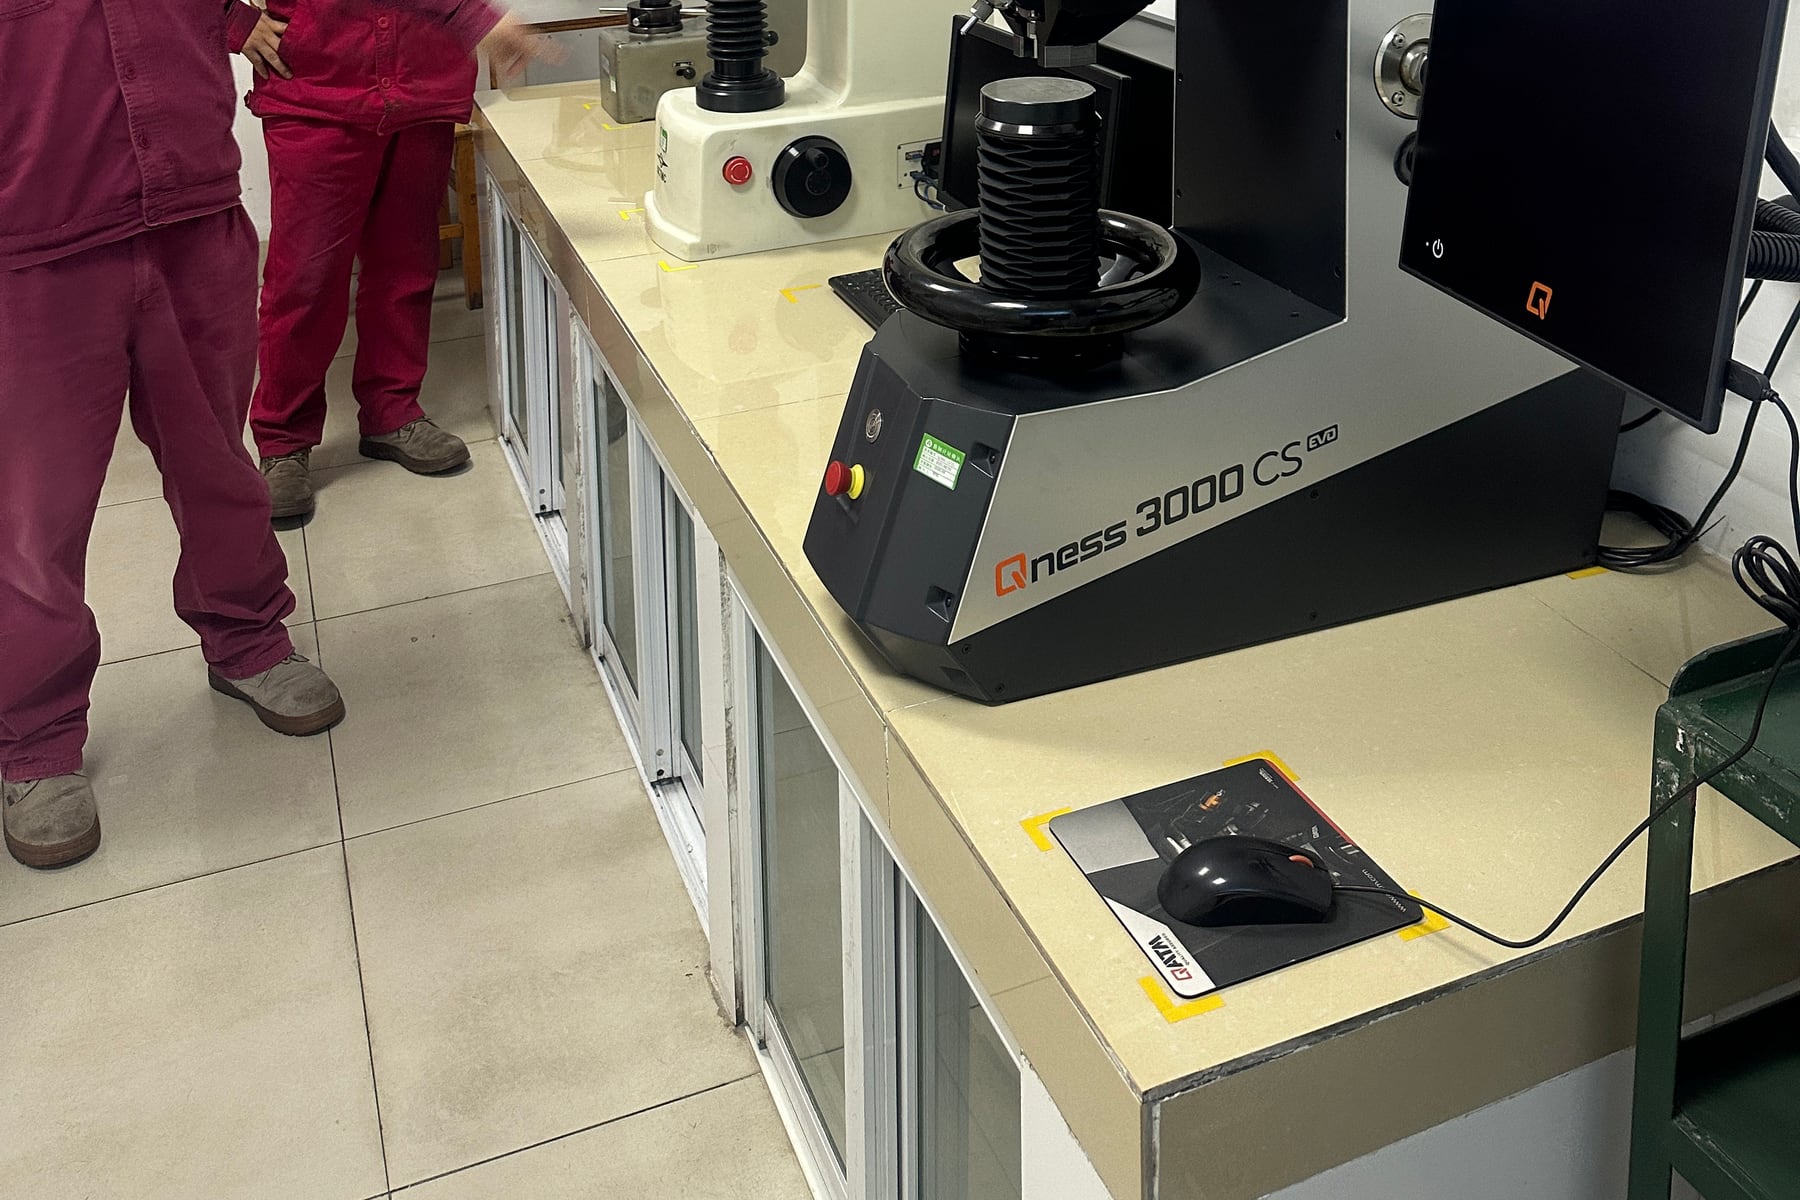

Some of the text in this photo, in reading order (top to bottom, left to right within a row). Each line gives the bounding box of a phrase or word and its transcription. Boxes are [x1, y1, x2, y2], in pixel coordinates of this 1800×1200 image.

[1526, 280, 1553, 320] Q
[995, 424, 1337, 598] Qness 3000 CS EVO
[1148, 935, 1193, 981] QATM
